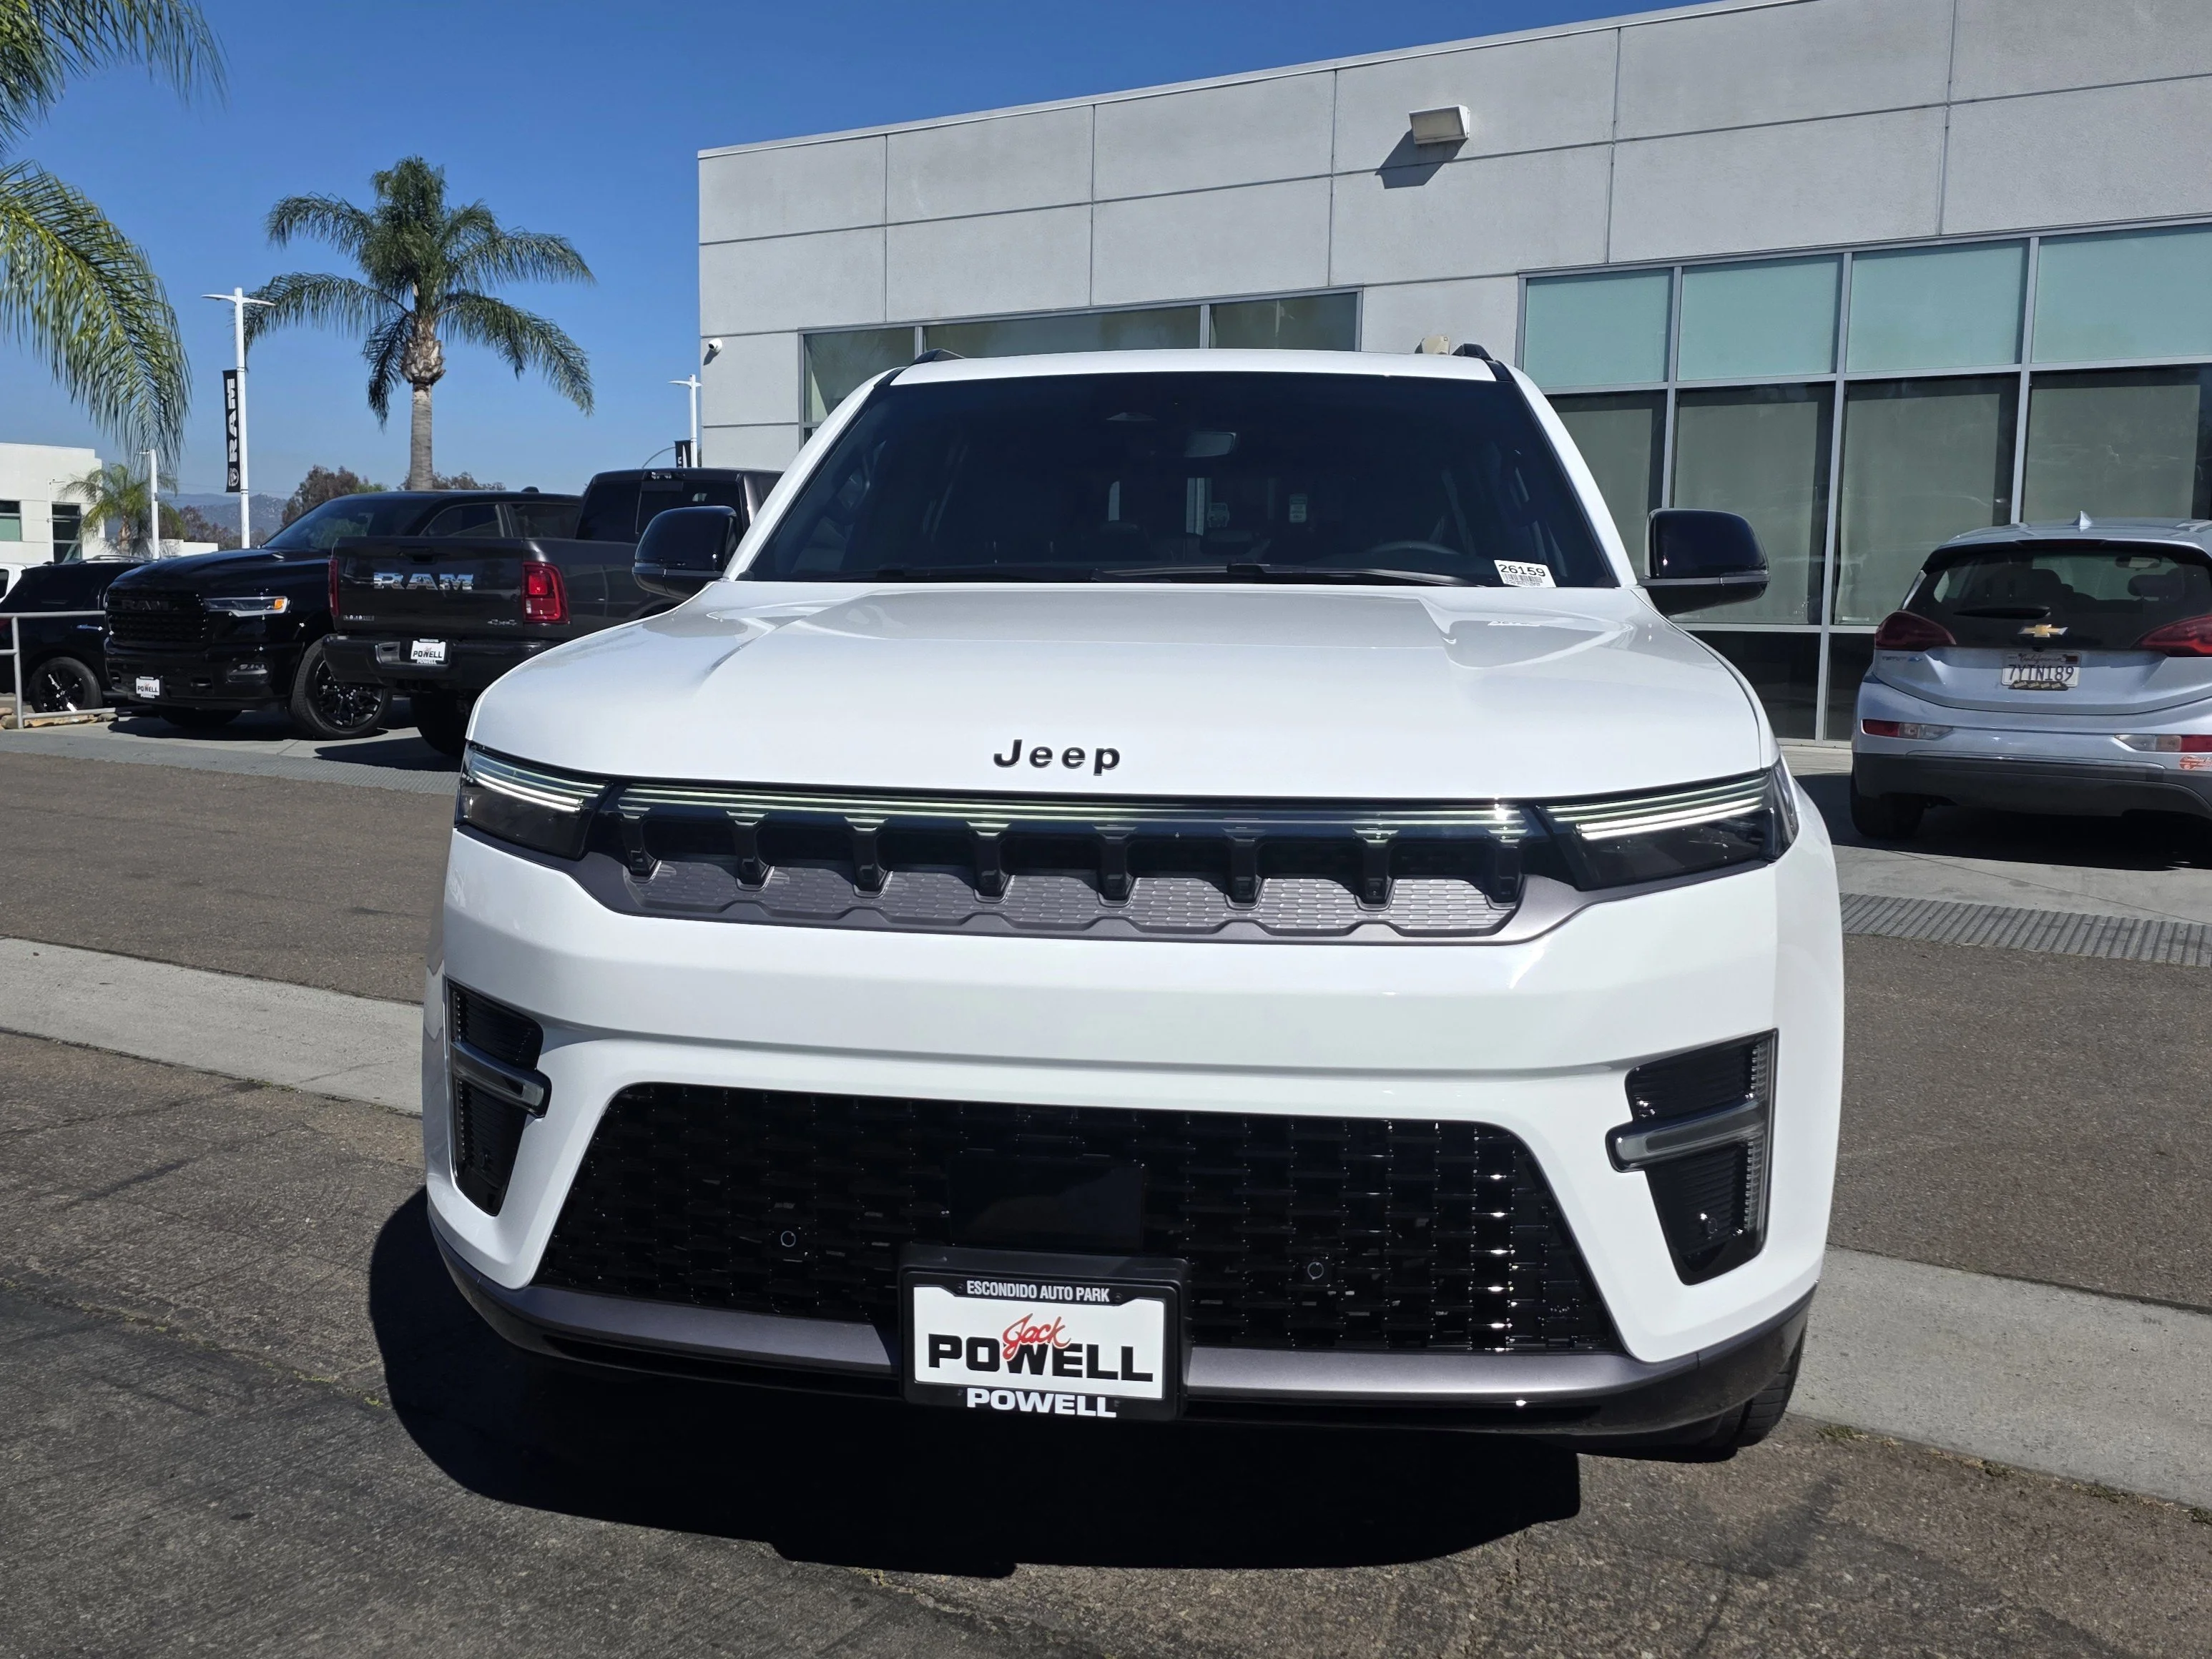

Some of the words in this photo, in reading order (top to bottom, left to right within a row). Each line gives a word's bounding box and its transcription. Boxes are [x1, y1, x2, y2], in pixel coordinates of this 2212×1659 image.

[227, 378, 237, 462] RAM
[373, 572, 473, 591] RAM
[1498, 564, 1545, 577] 26159
[2007, 664, 2075, 682] 7YTN189
[993, 739, 1121, 777] Jeep
[967, 1280, 1037, 1299] ESCONDIDO
[1040, 1285, 1073, 1301] AUTO
[1076, 1288, 1110, 1302] PARK
[1003, 1313, 1071, 1361] Jack
[928, 1333, 1154, 1382] POWELL
[967, 1387, 1117, 1418] POWELL
